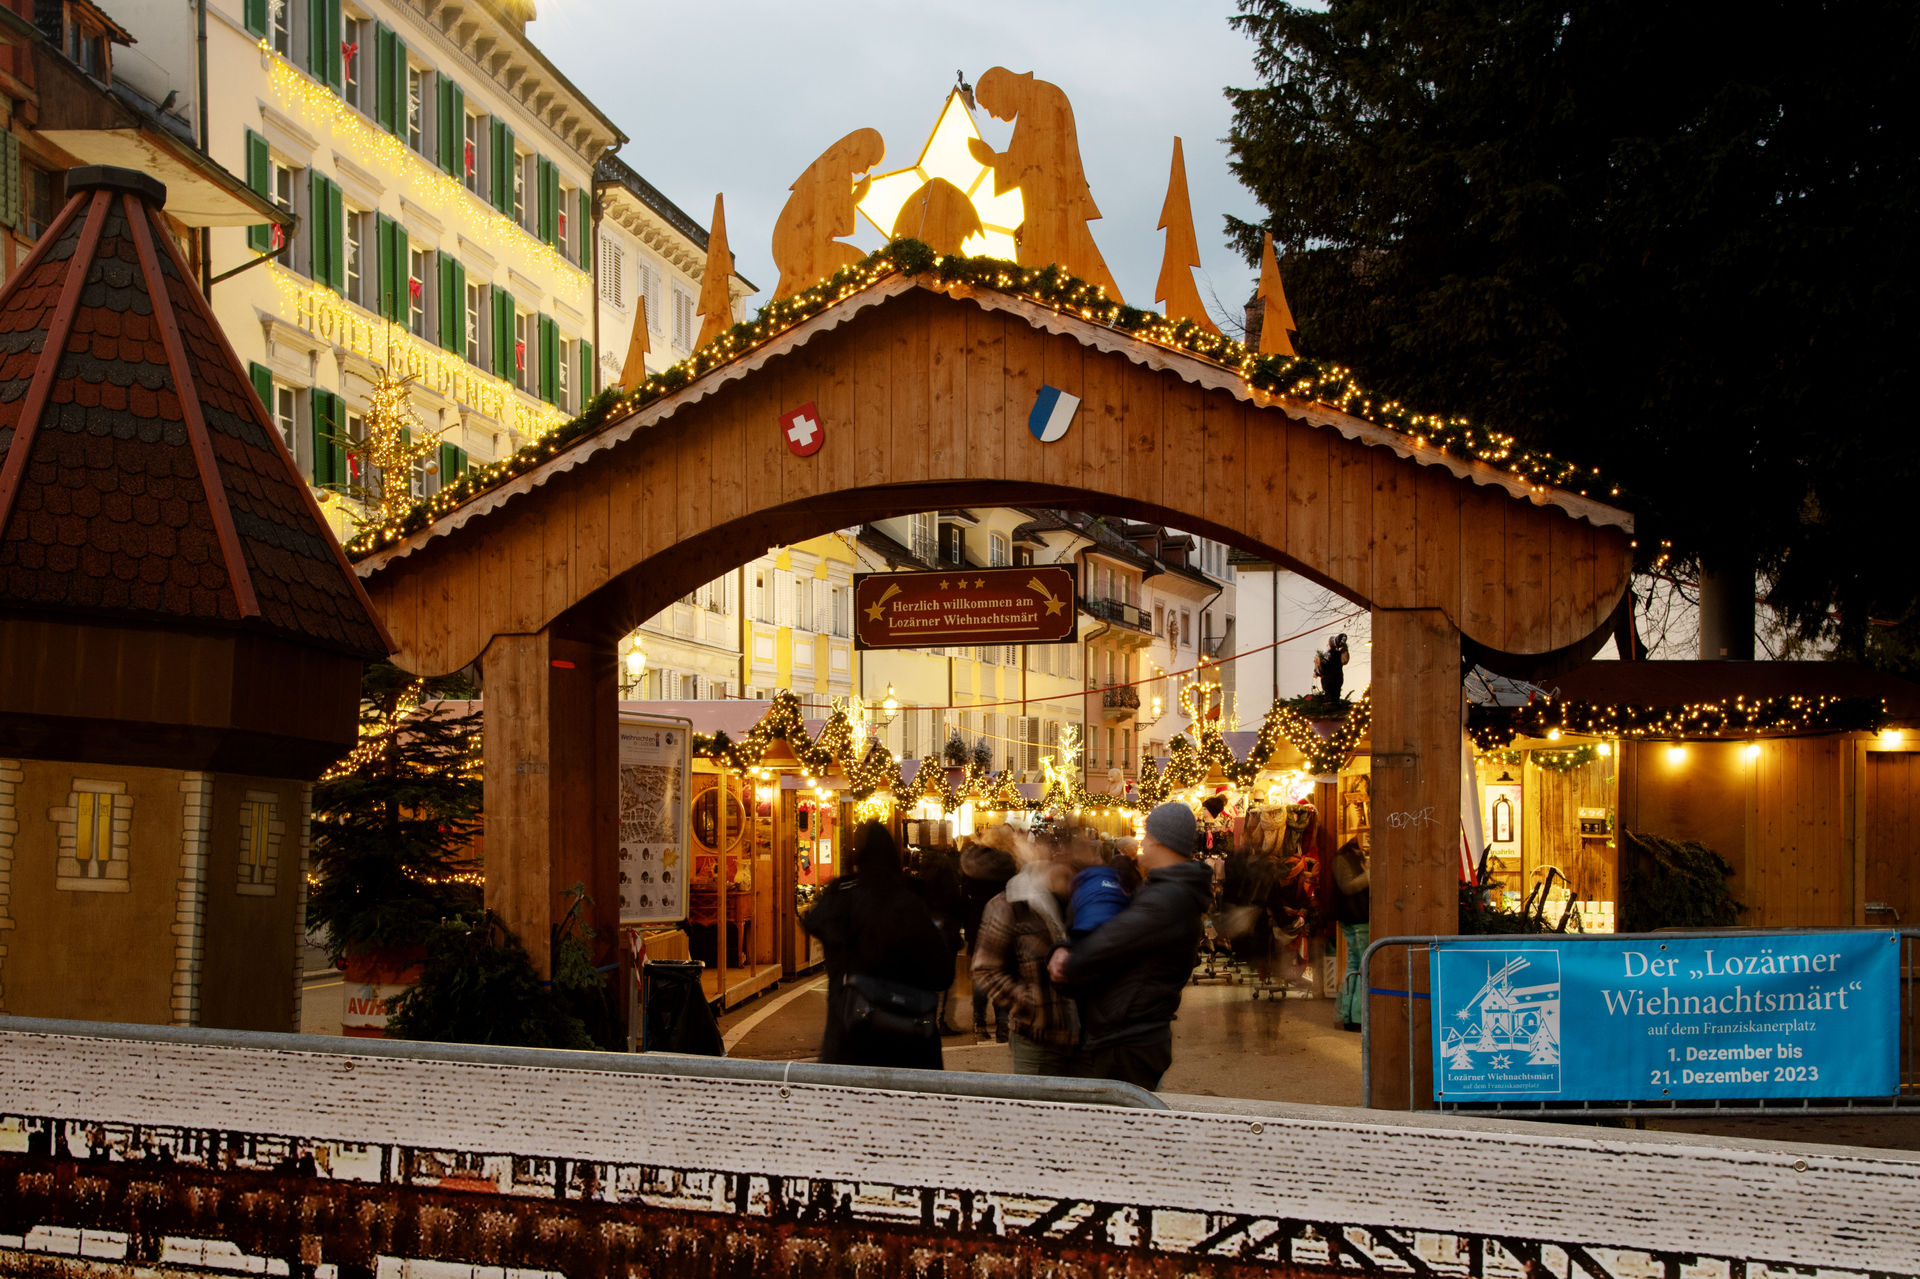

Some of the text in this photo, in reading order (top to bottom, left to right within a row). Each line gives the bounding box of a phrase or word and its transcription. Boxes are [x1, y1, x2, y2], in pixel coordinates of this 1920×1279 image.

[297, 290, 382, 364] HOTEL
[391, 339, 505, 425] GOLDENER
[893, 598, 1034, 612] Herzlich willkommen am
[888, 612, 1038, 628] Lozärner Wiehnachtsmärt
[1622, 949, 1841, 980] Der „Lozärner
[1601, 980, 1862, 1016] Wiehnachtsmärt“
[1647, 1019, 1817, 1036] auf dem Franziskanerplatz
[1668, 1043, 1803, 1062] 1. Dezember bis
[1448, 1072, 1554, 1081] Lozärner Wiehnachtsmärt
[1650, 1066, 1819, 1085] 21. Dezember 2023
[1487, 1082, 1540, 1090] Franziskanerplatz
